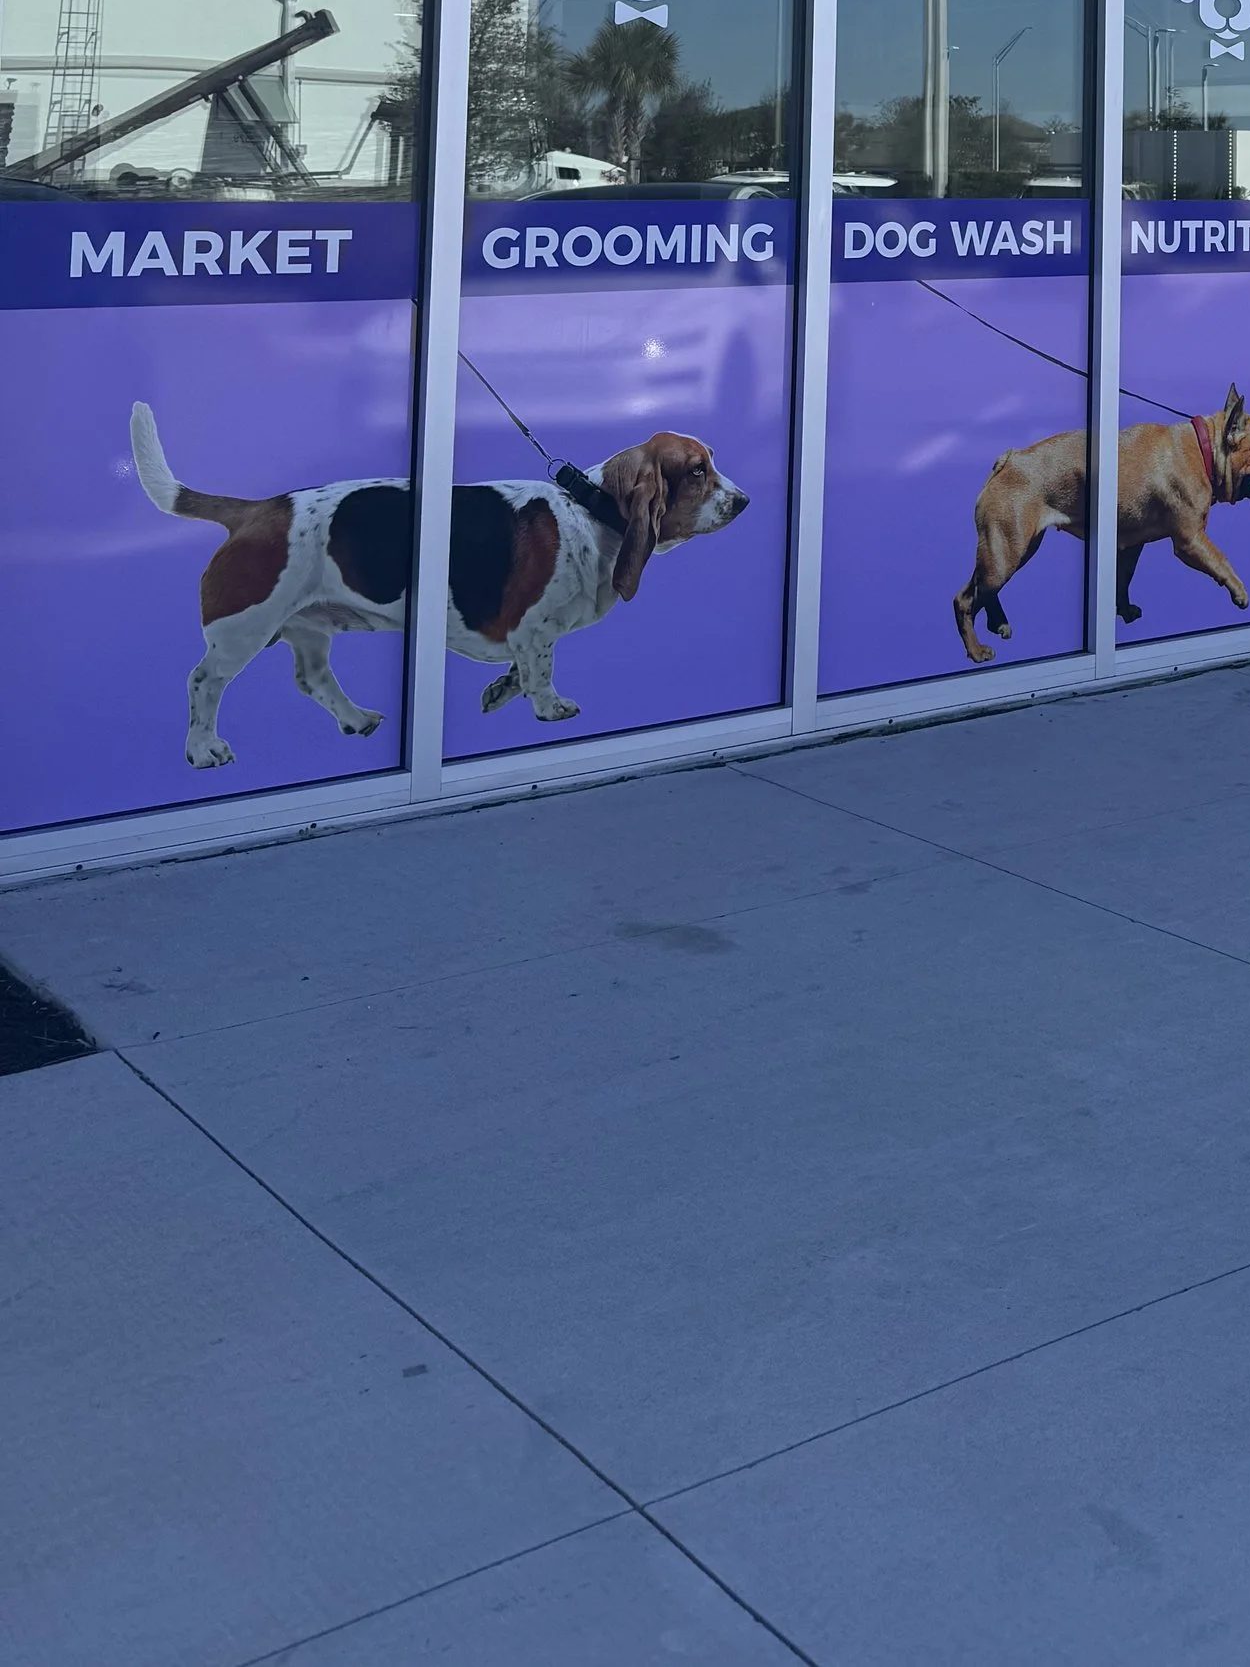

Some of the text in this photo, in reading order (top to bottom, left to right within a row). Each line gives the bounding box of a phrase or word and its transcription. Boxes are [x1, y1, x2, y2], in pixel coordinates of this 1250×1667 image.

[69, 229, 353, 278] MARKET
[482, 223, 775, 269] GROOMING
[843, 220, 1073, 259] DOG WASH
